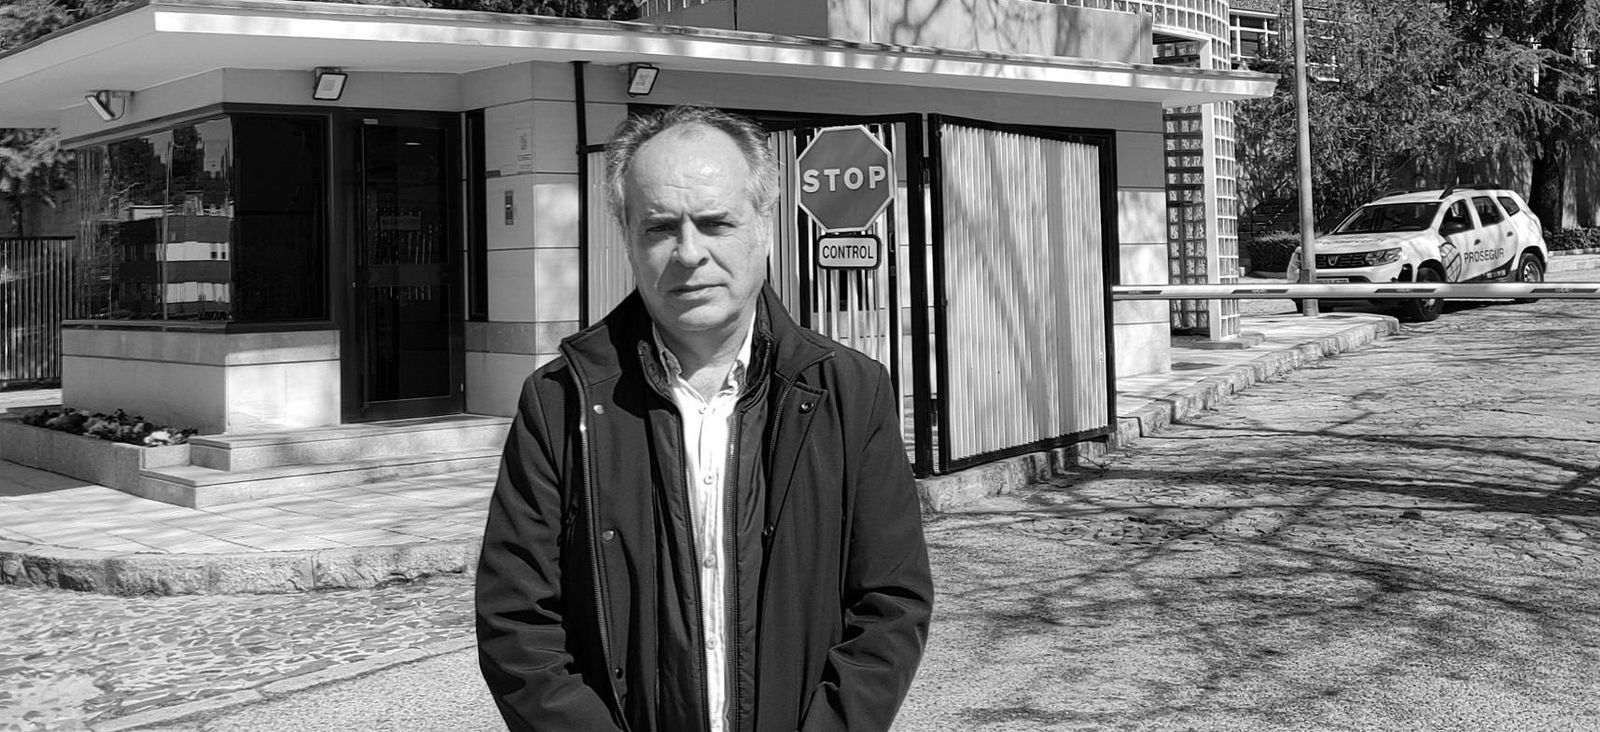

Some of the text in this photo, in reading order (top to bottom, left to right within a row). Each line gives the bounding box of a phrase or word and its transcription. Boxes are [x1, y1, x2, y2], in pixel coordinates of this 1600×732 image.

[801, 165, 886, 193] STOP
[822, 245, 874, 259] CONTROL
[1464, 248, 1504, 263] PROSEGUR
